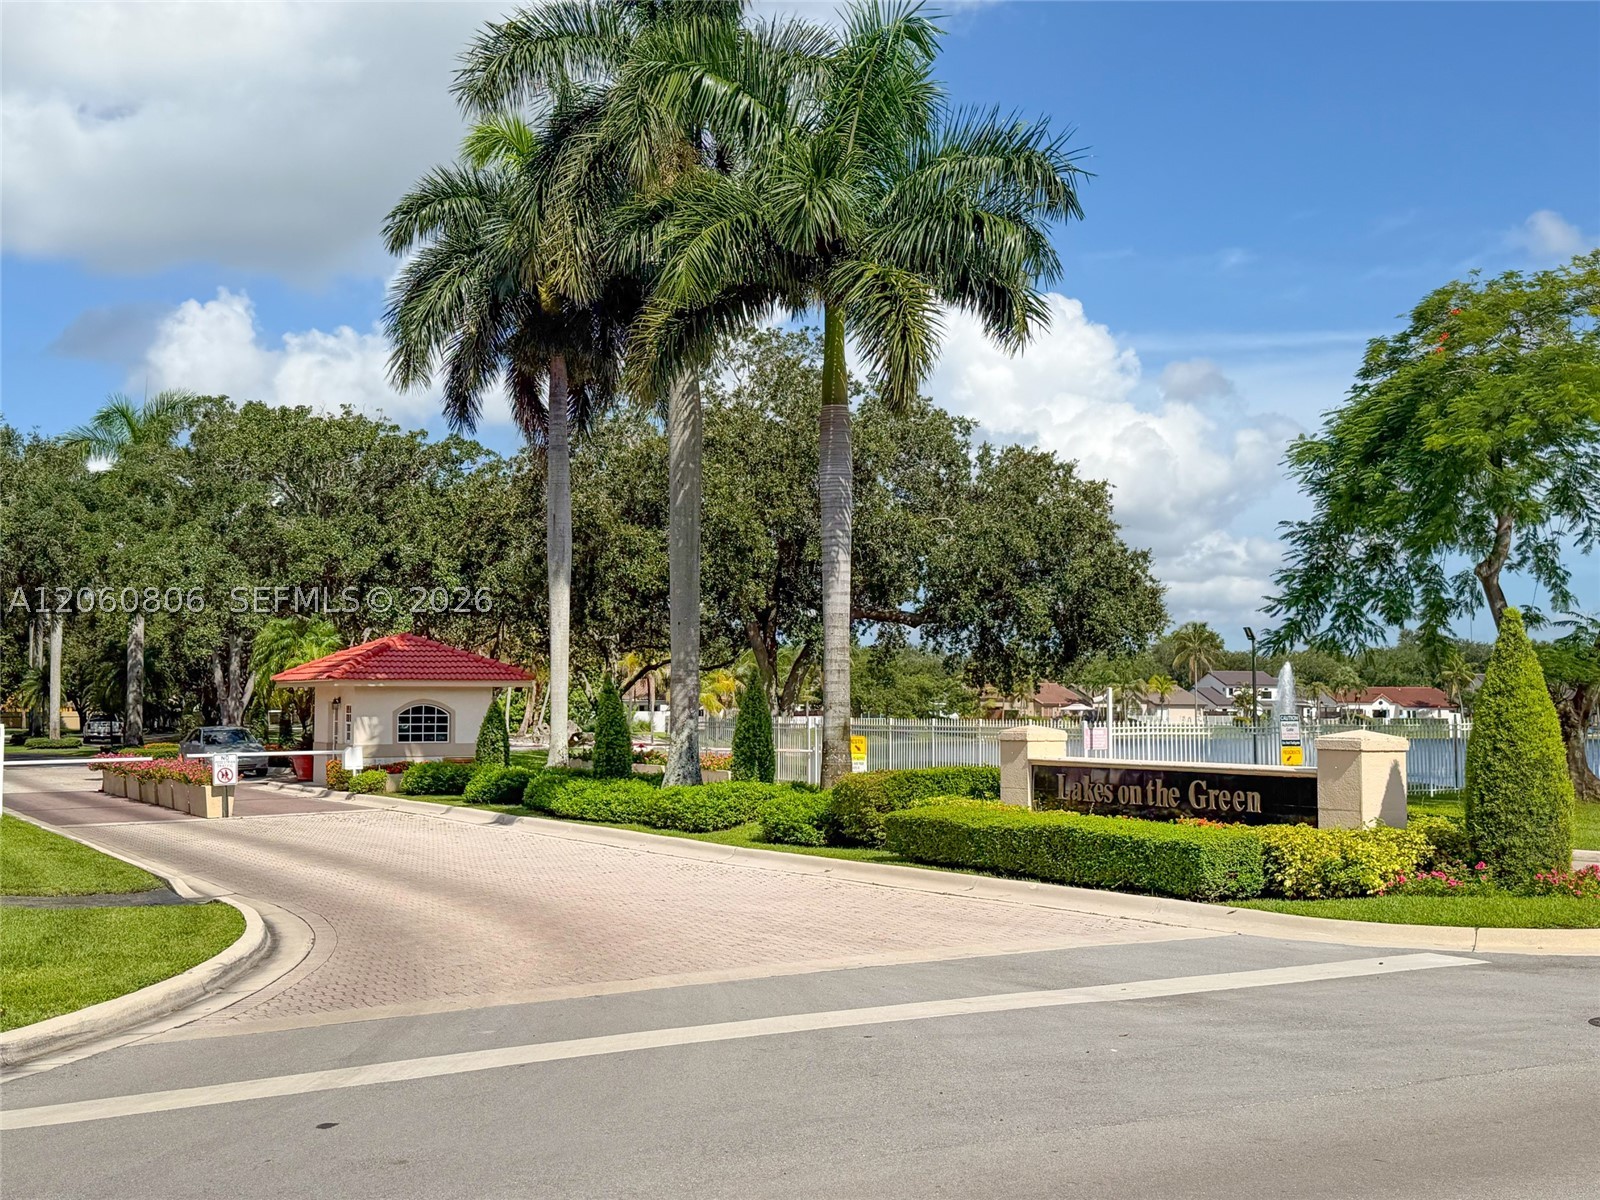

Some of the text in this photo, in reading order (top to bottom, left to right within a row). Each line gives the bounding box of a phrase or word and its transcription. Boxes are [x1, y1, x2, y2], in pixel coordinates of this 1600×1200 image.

[1056, 773, 1262, 814] Lakes on the Green
